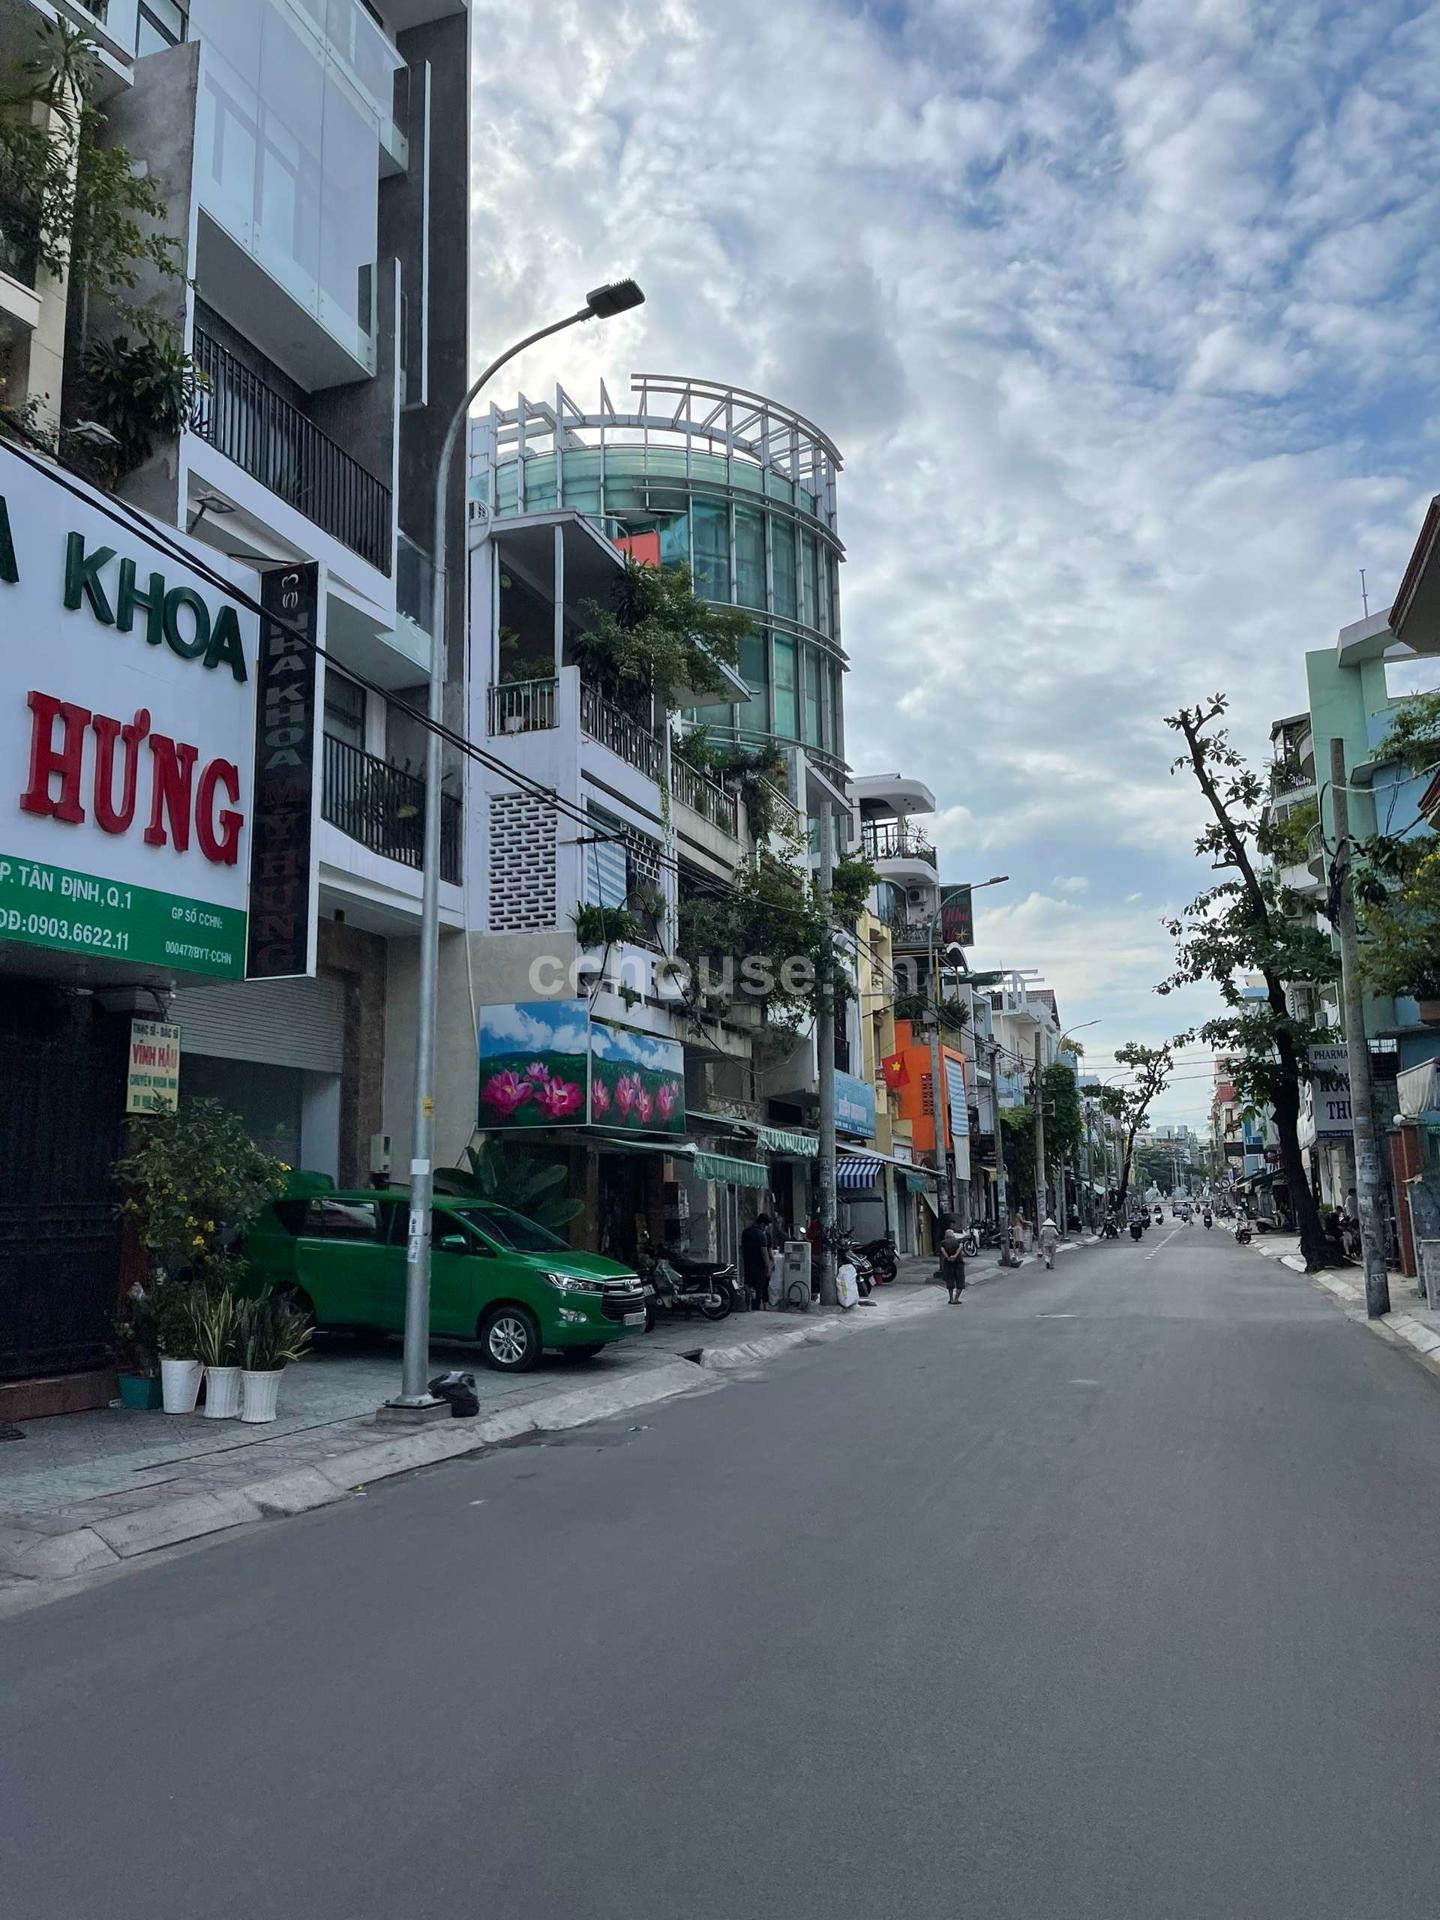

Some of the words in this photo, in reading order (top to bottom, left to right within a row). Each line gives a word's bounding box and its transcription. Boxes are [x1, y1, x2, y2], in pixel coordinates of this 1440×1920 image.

[63, 531, 248, 682] KHOA
[264, 682, 306, 769] KHOA
[20, 690, 244, 866] HƯNG
[18, 864, 54, 893] TÂN
[171, 906, 183, 920] GP
[1313, 1049, 1349, 1060] PHARMA
[1326, 1100, 1353, 1120] TH
